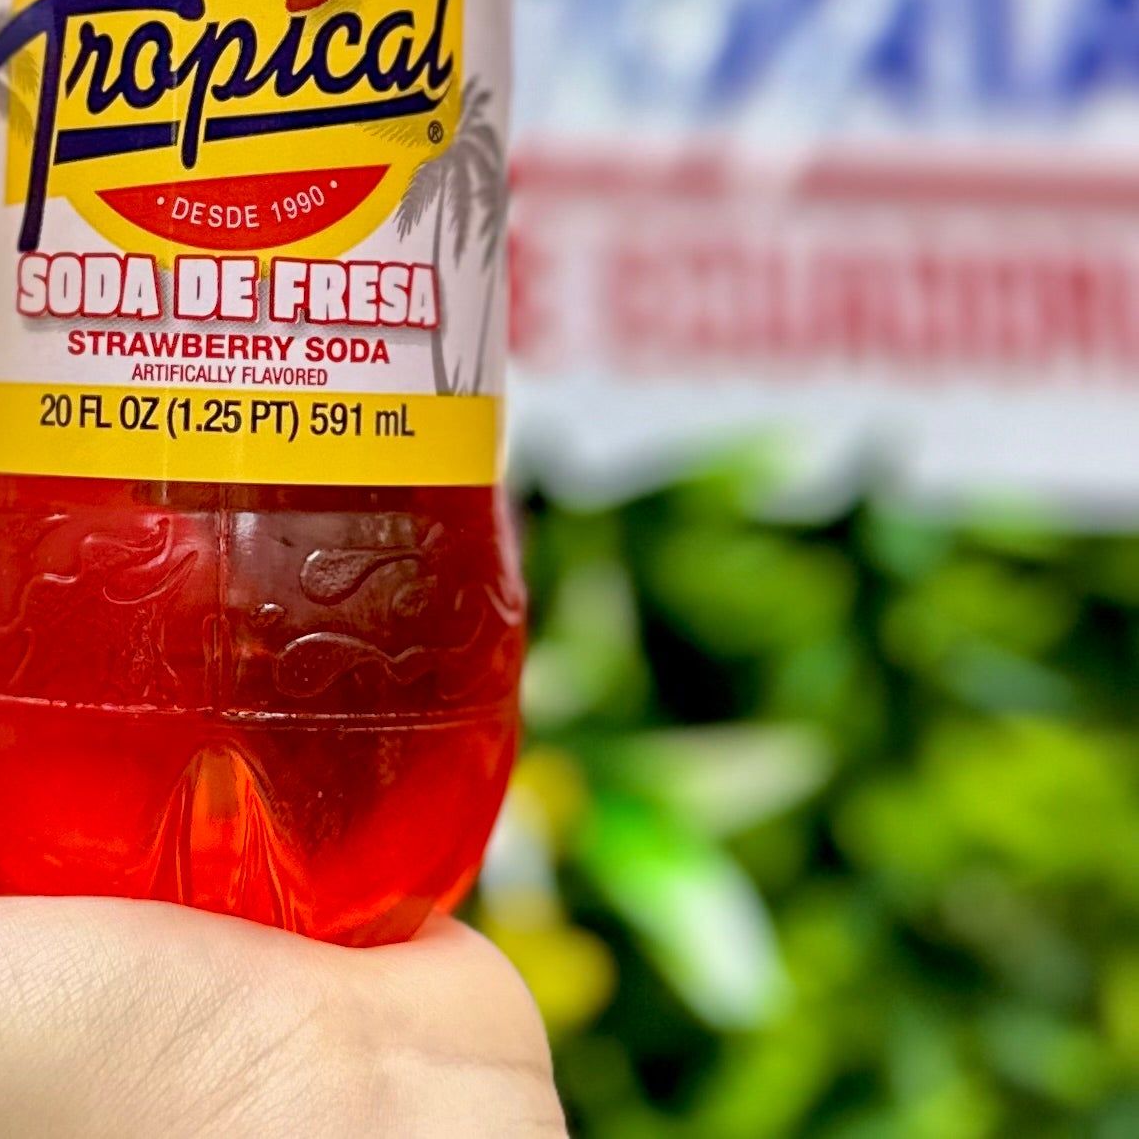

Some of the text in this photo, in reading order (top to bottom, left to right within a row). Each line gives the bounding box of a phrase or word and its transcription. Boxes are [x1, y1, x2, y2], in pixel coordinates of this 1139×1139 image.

[171, 185, 325, 230] DESDE 1990
[16, 252, 162, 320] SODA
[173, 256, 260, 322] DE
[269, 257, 441, 330] FRESA
[67, 330, 390, 364] STRAWBERRY SODA
[131, 363, 329, 387] ARTIFICALLY FLAVORED
[39, 395, 415, 442] 20 FL OZ (1.25 PT) 591 mL
